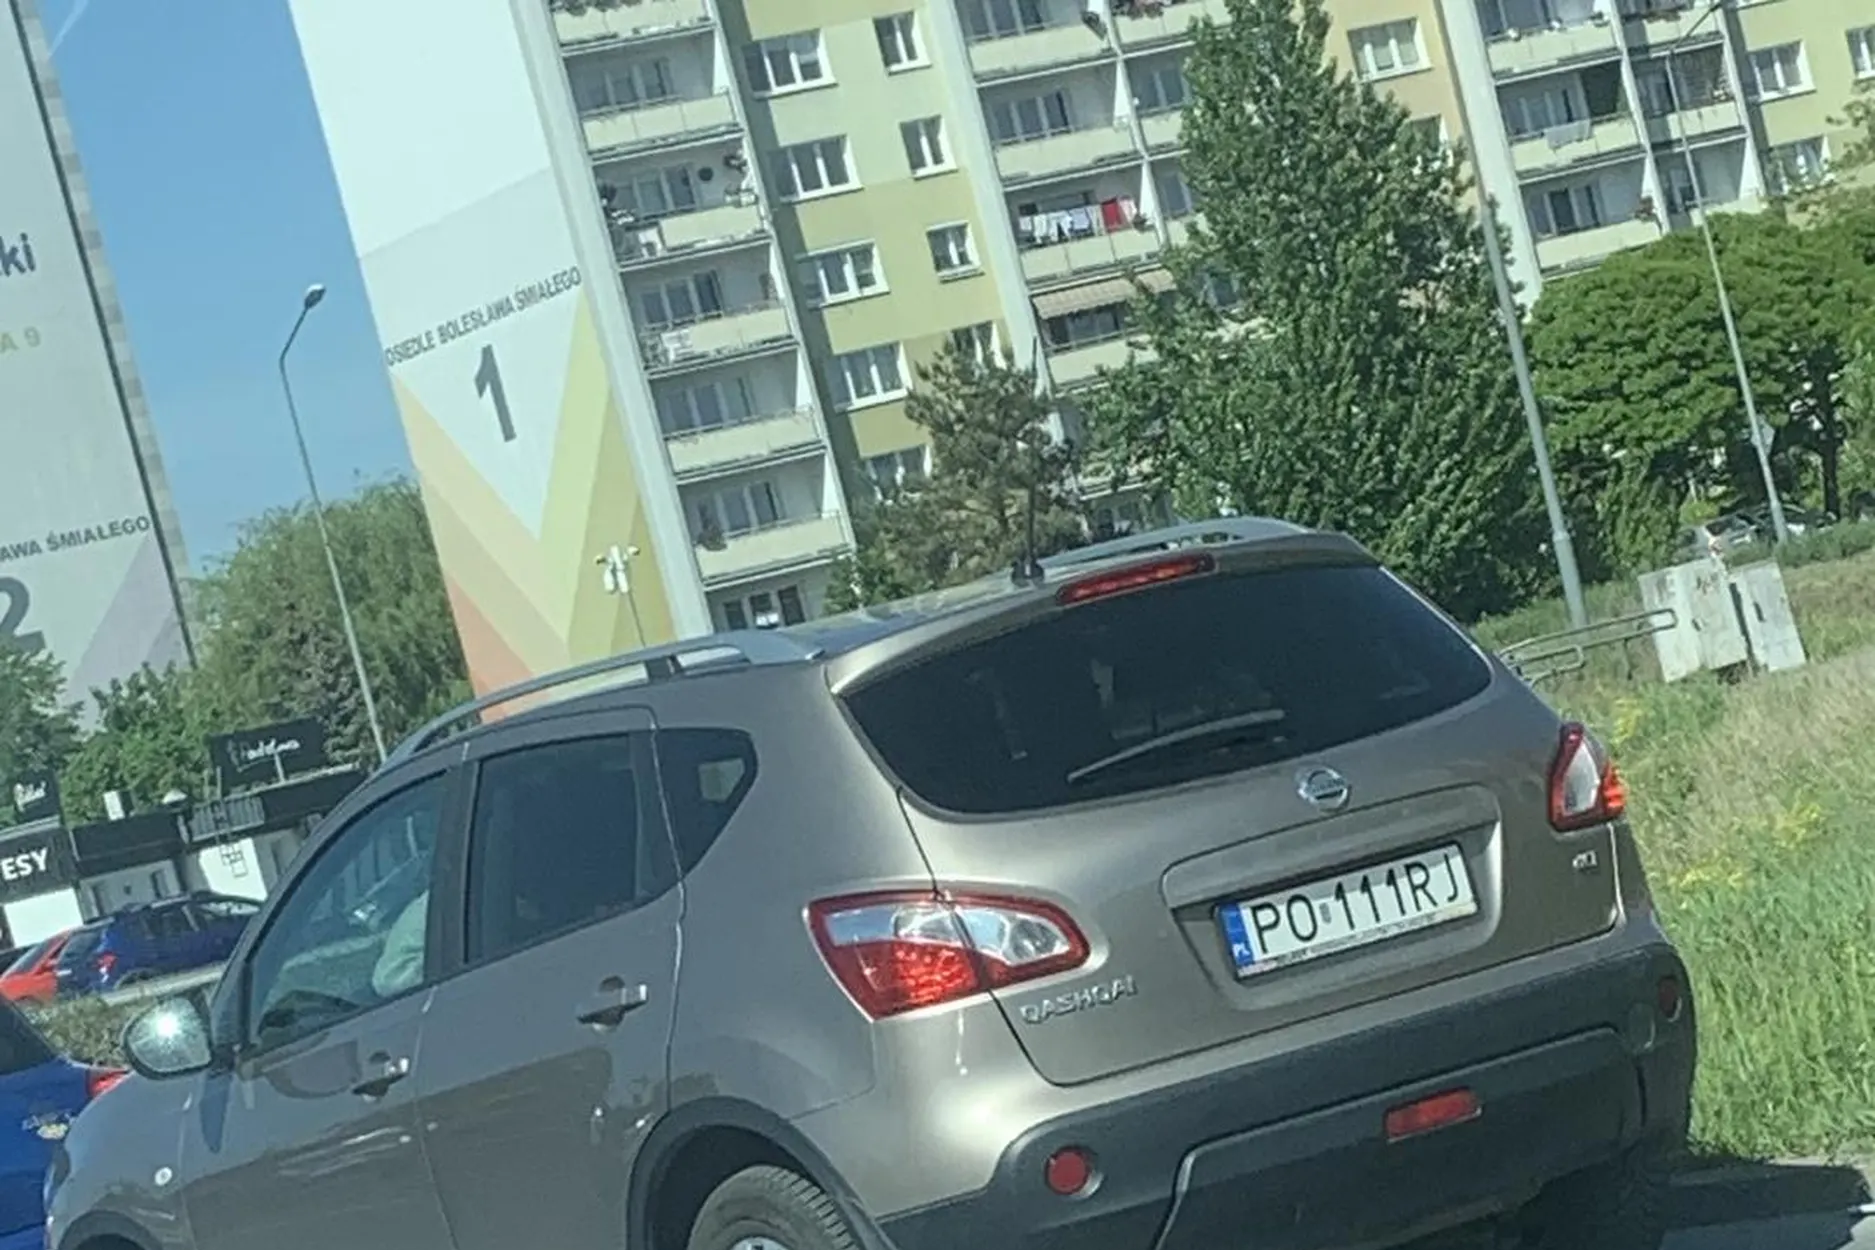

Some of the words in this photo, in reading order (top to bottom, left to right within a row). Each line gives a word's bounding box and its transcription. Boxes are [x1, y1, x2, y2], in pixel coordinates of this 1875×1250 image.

[0, 231, 36, 278] ki
[23, 325, 41, 348] 9
[384, 329, 436, 367] OSIEDLE
[474, 344, 517, 443] 1
[0, 576, 46, 654] 2
[1, 847, 48, 880] ESY
[1250, 894, 1318, 954] PO
[1334, 853, 1459, 931] 111RJ
[1020, 975, 1138, 1024] QASHQAI
